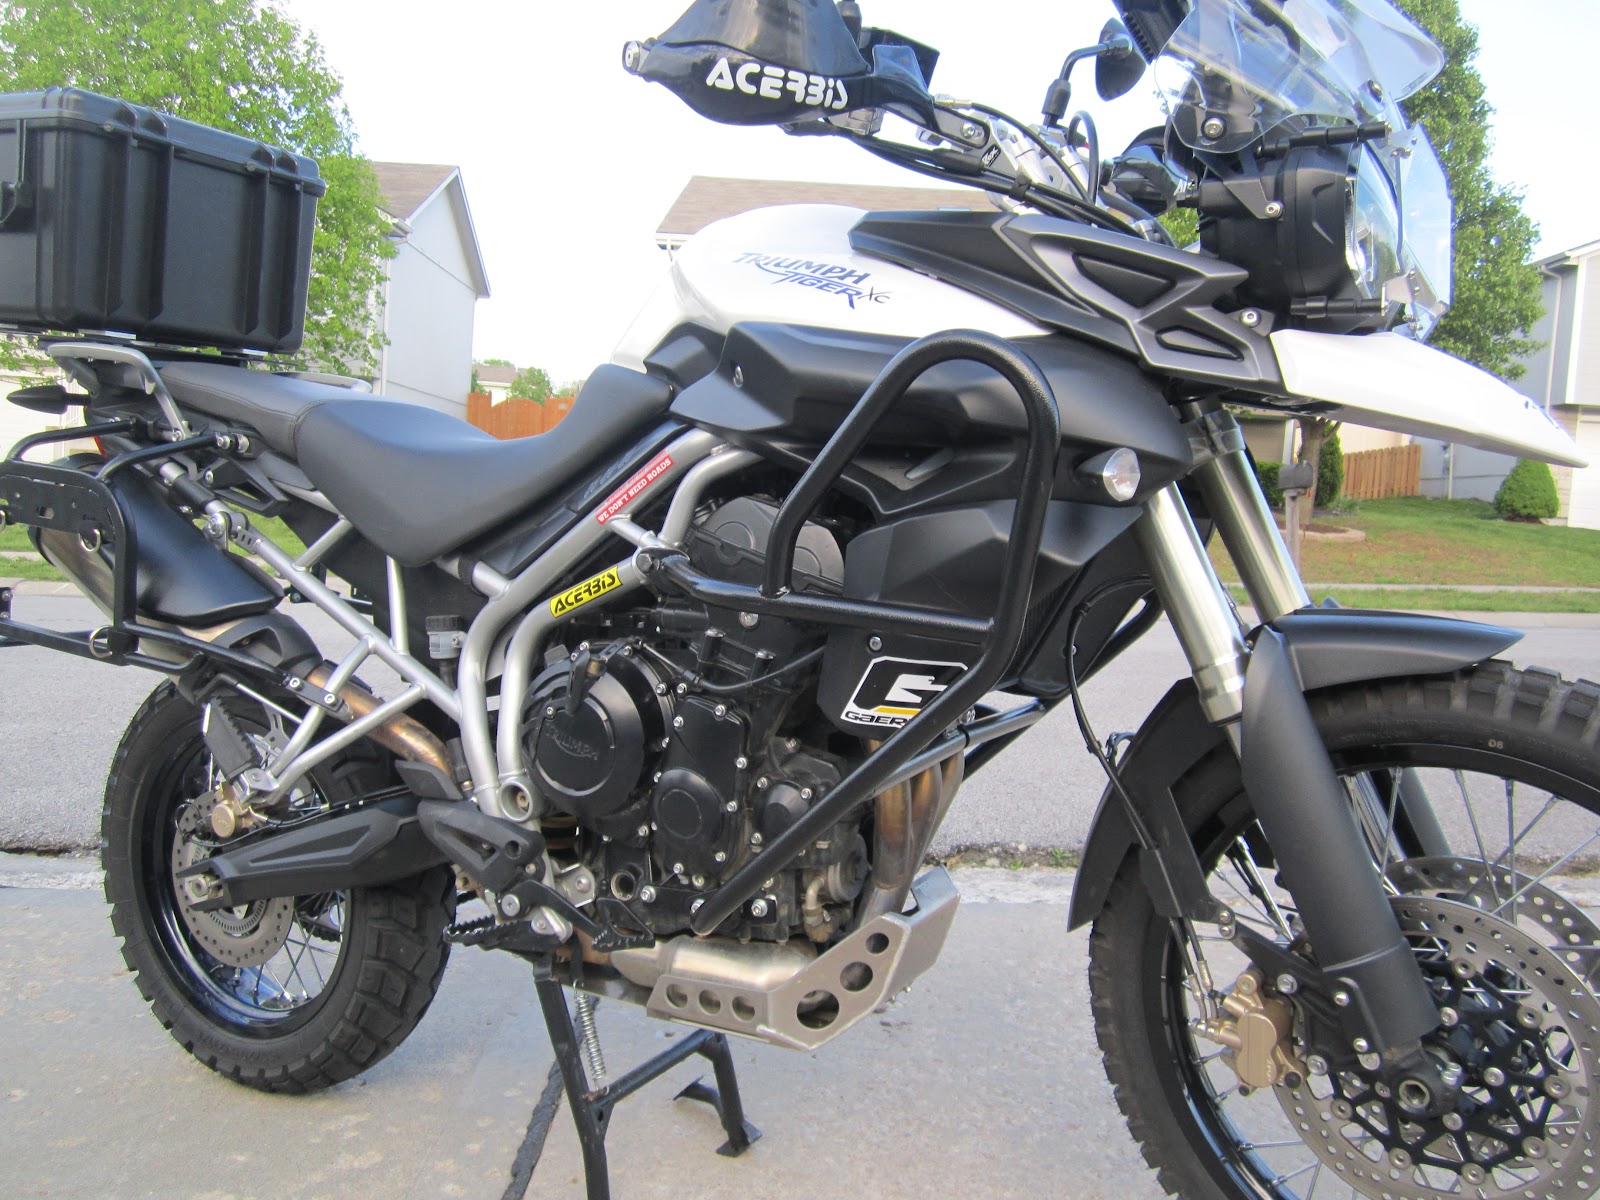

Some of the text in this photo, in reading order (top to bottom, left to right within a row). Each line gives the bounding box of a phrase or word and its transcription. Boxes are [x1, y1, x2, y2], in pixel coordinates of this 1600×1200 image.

[705, 57, 848, 110] ACERBIS
[731, 252, 872, 285] TRIUMPH
[771, 270, 864, 310] TIGER
[597, 458, 672, 522] WE DON'T NEED ROADS
[554, 572, 616, 614] ACERBIS
